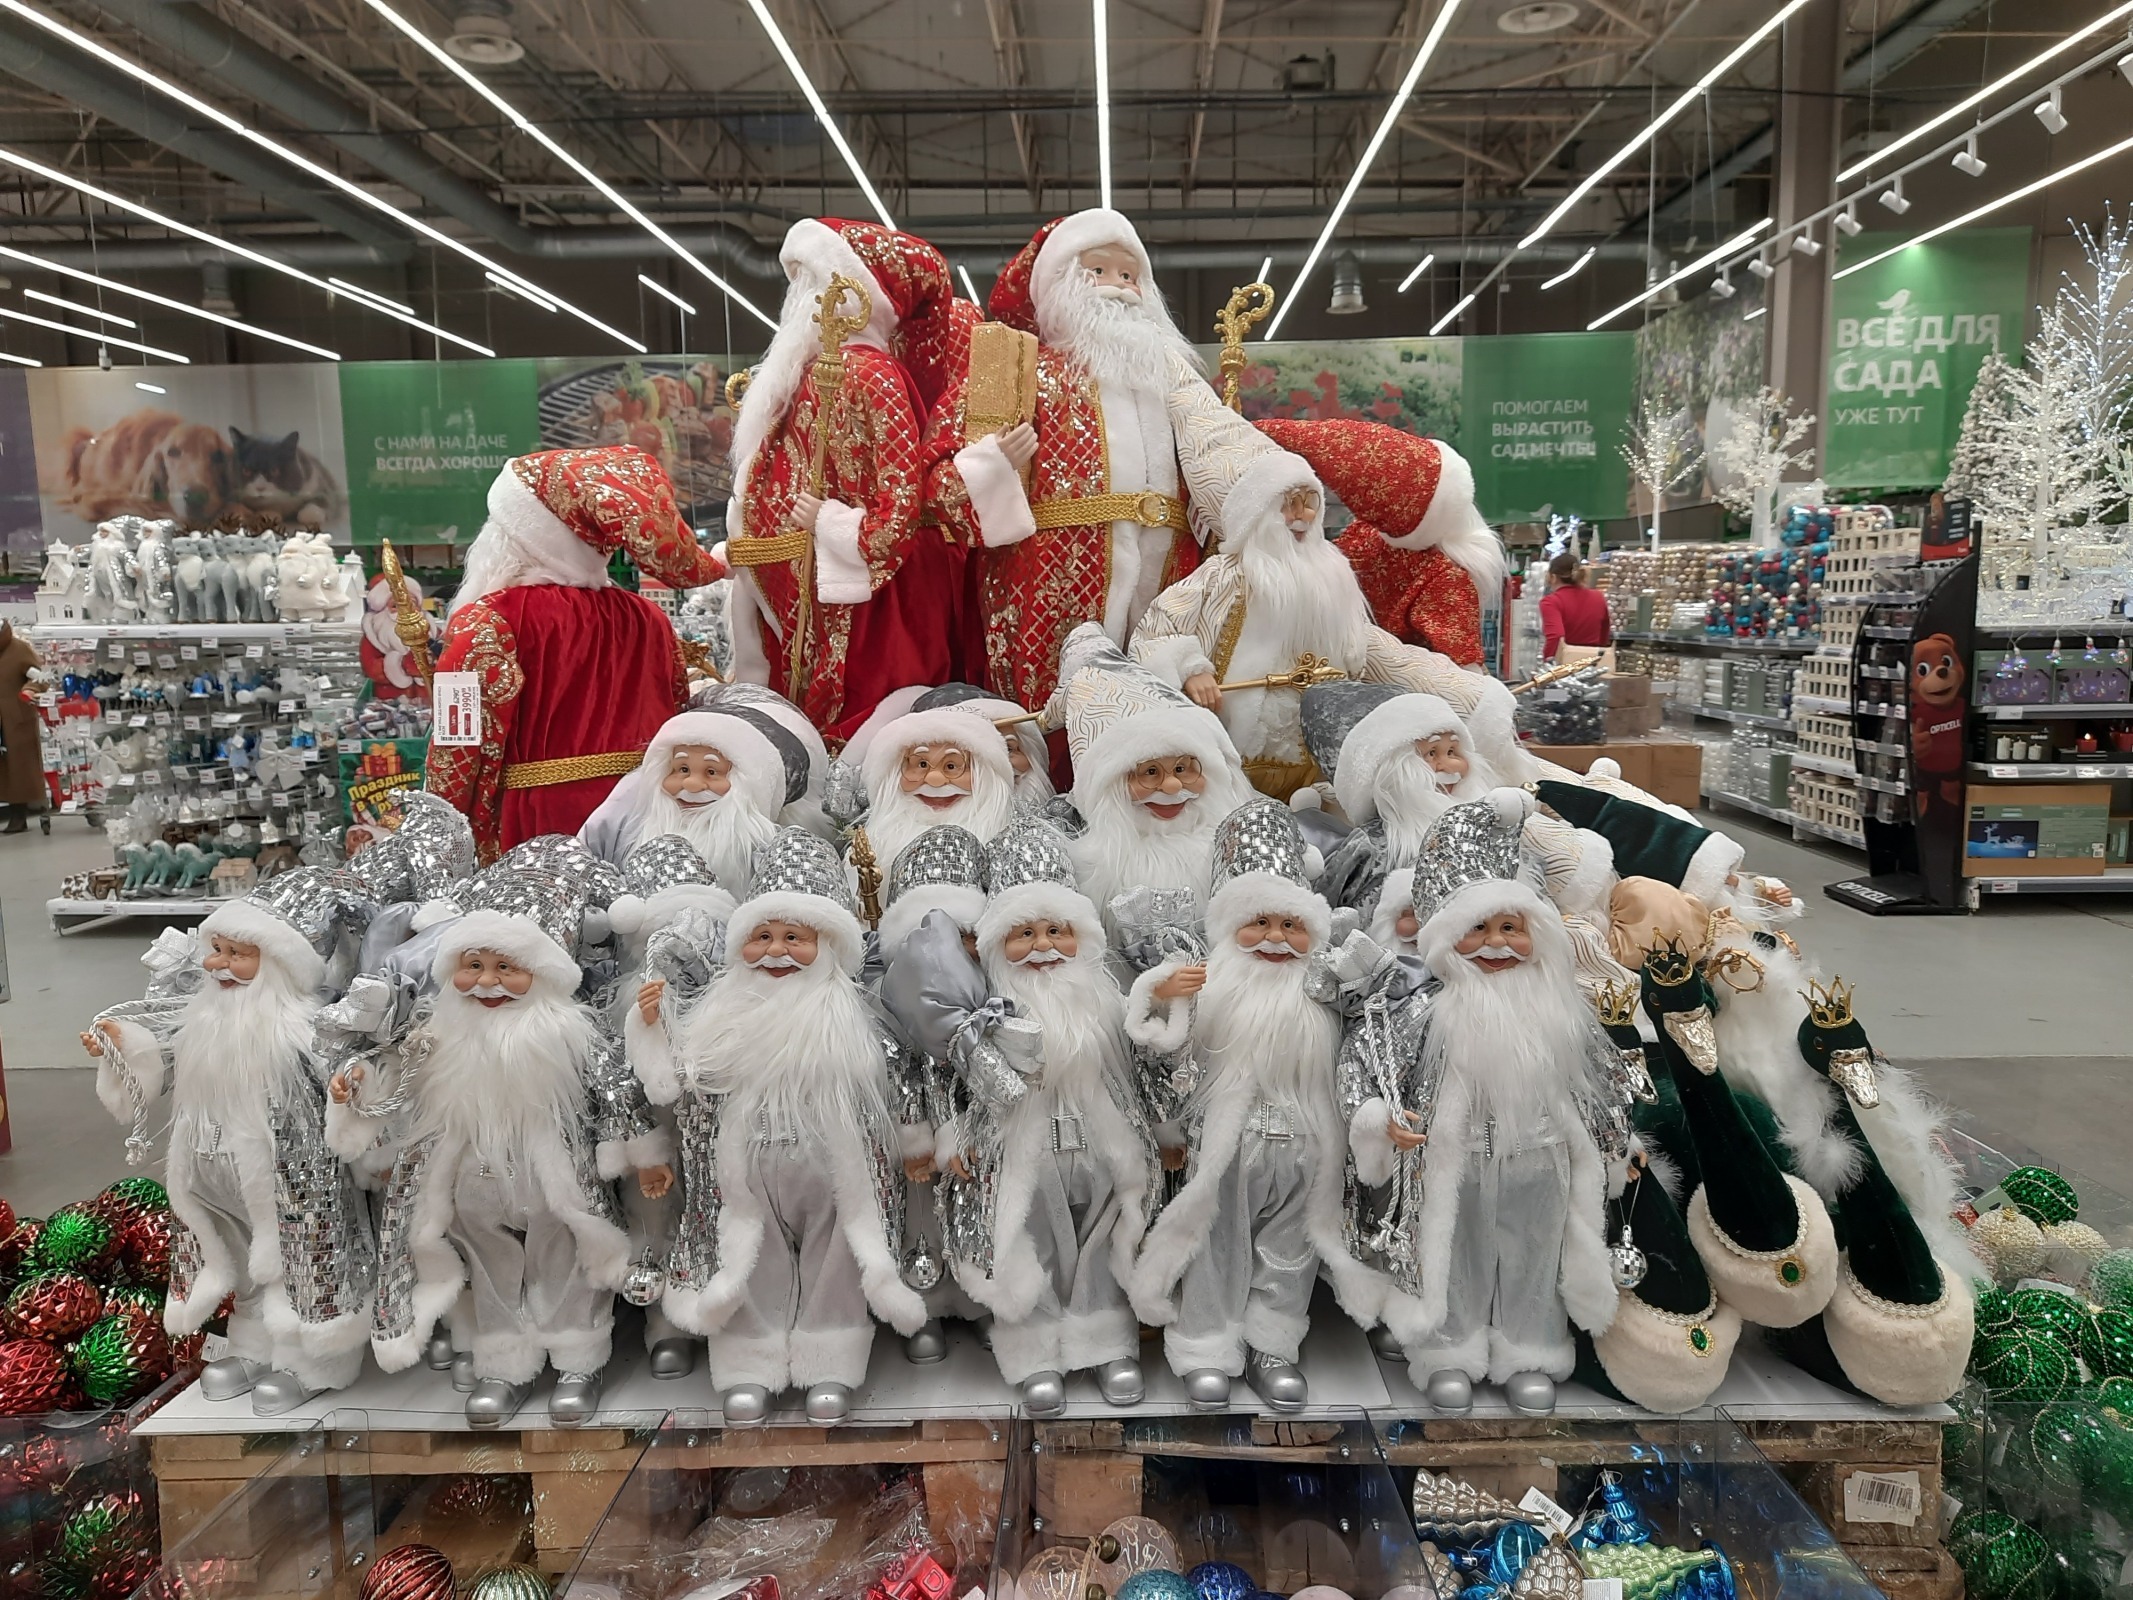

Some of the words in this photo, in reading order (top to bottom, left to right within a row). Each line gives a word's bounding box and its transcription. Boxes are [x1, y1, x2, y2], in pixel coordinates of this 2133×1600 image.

[1912, 314, 2001, 354] ДЛЯ
[1833, 359, 1942, 399] САДА
[1492, 399, 1588, 416] ПОМОГАЕМ
[1834, 407, 1880, 425] УЖЕ
[1885, 406, 1924, 425] ТУТ
[1491, 420, 1594, 437] ВЫРАСТИТЬ
[374, 436, 385, 451] С
[388, 436, 436, 450] НАМИ
[439, 435, 462, 449] НА
[464, 434, 509, 452] ДАЧЕ
[1491, 443, 1528, 460] САД
[376, 456, 436, 473] ВСЕГДА
[1930, 718, 1962, 735] OPTICELL
[348, 772, 421, 801] Праздник
[355, 801, 366, 812] в
[368, 783, 408, 805] твох
